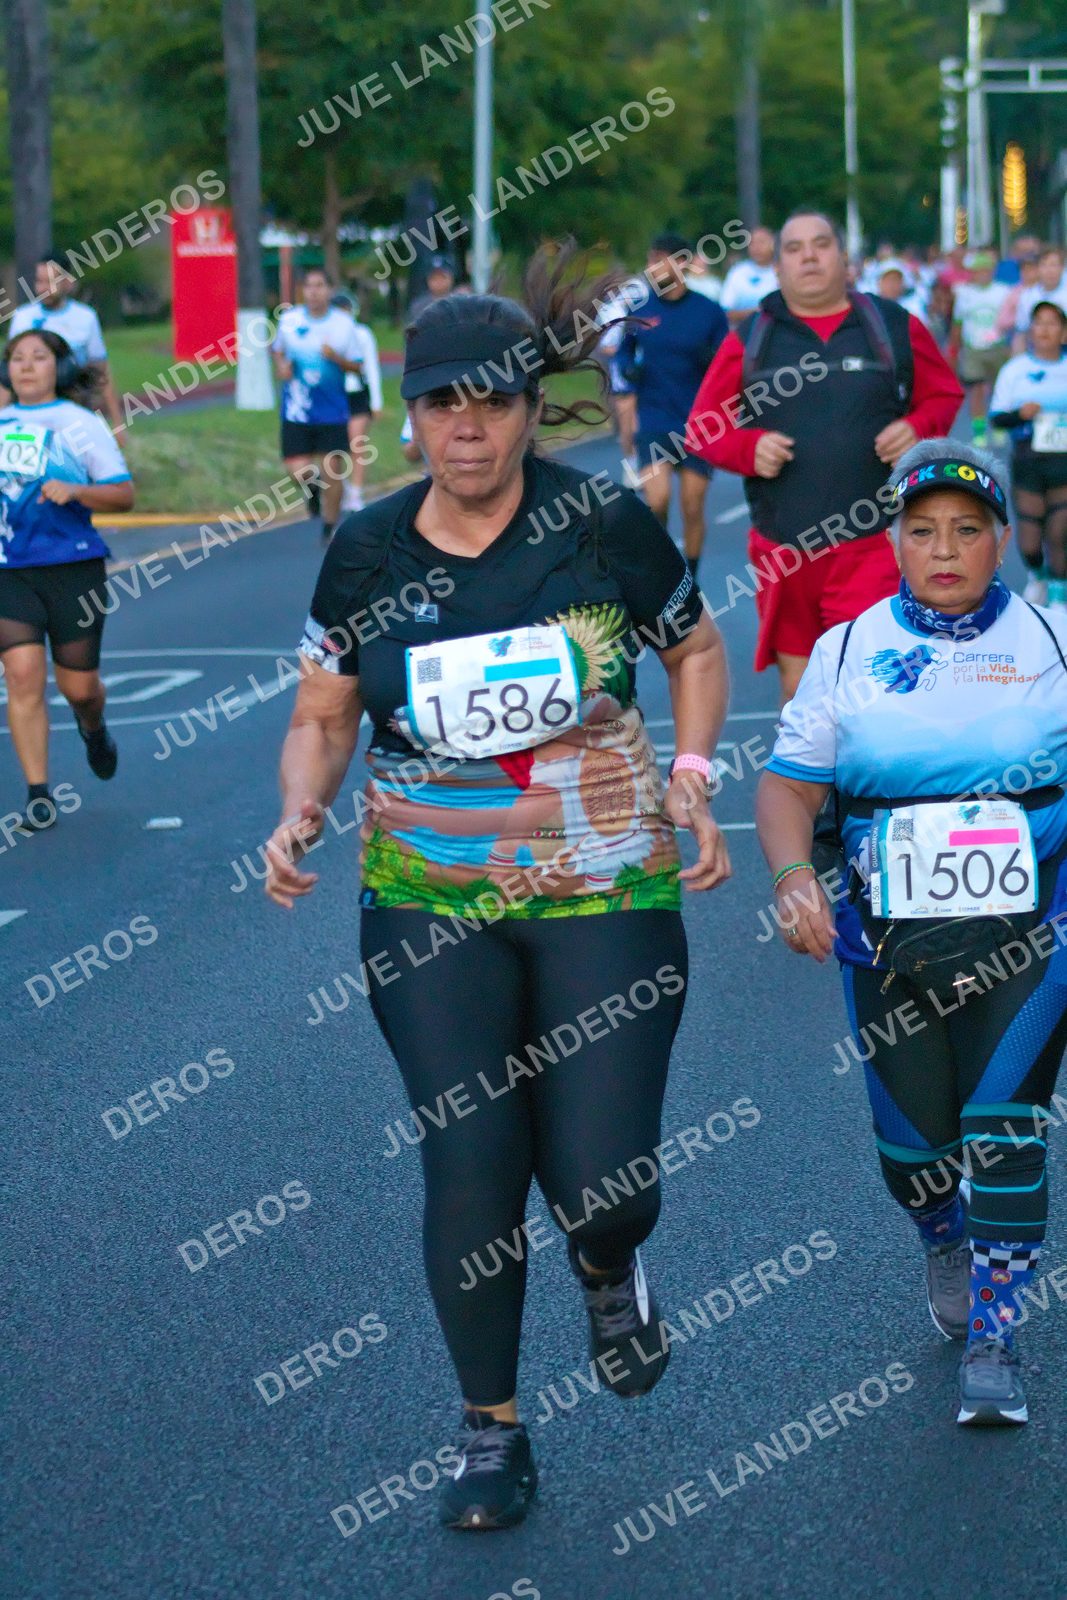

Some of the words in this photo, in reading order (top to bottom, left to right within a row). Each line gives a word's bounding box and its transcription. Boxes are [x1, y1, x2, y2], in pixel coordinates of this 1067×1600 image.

[953, 652, 1015, 664] Carrera
[953, 665, 973, 675] por
[975, 663, 986, 673] la
[988, 663, 1017, 674] Vida
[953, 676, 960, 686] y
[963, 673, 974, 683] la
[977, 673, 1041, 685] Integridad
[425, 677, 572, 743] 1586
[897, 848, 1029, 901] 1506
[872, 885, 880, 905] 1506
